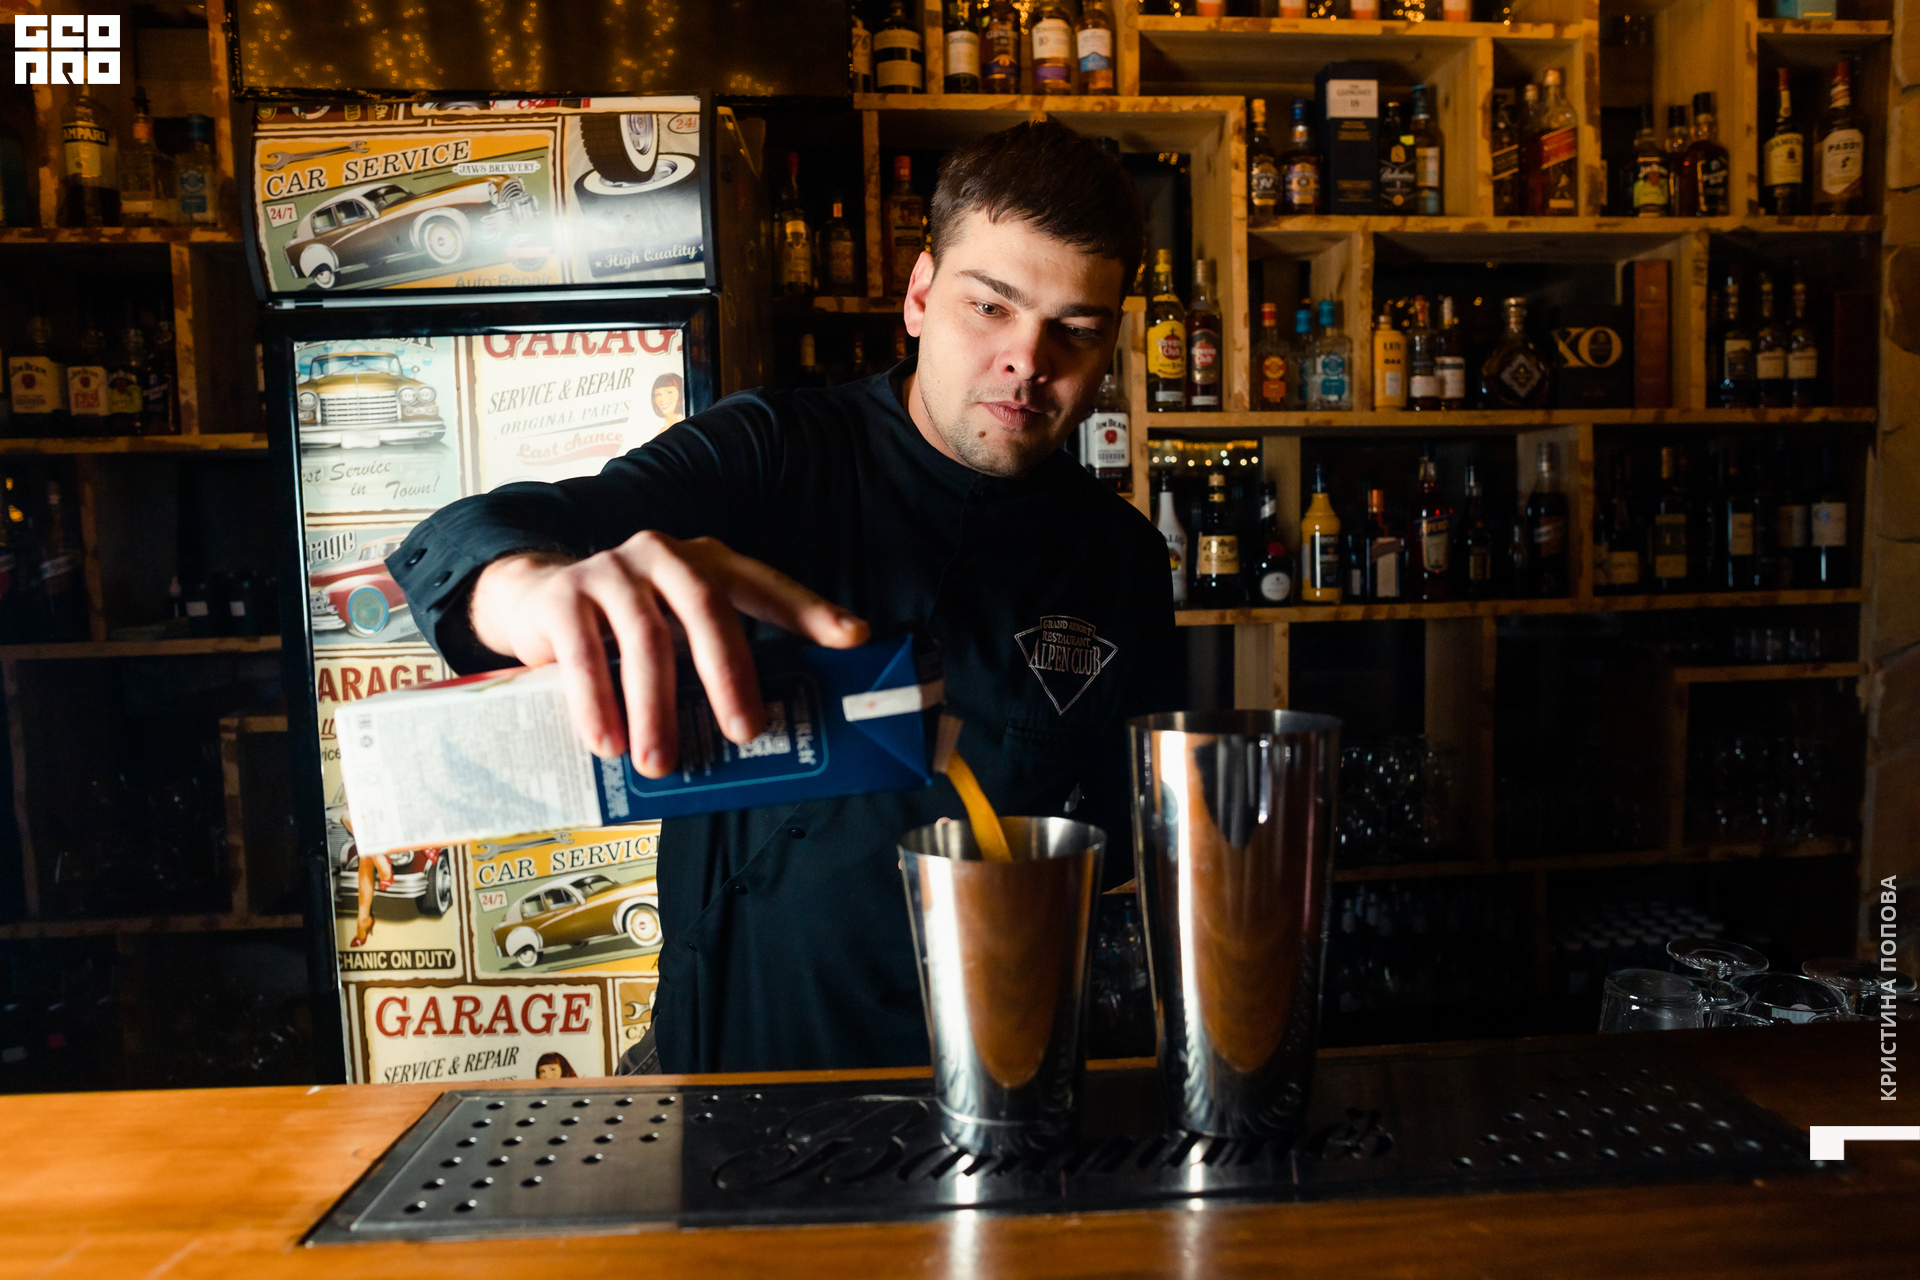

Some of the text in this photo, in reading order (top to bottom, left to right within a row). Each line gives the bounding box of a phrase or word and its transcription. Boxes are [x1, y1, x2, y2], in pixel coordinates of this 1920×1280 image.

[266, 140, 471, 198] CAR SERVICE
[459, 162, 535, 174] JAWS BREWERY
[270, 207, 294, 221] 24/7
[604, 244, 698, 270] High Quality
[455, 273, 552, 287] Auto Repair
[484, 329, 683, 359] GARAG
[1550, 326, 1623, 368] XO
[488, 367, 635, 415] SERVICE & REPAIR
[500, 400, 631, 435] ORIGINAL PARTS
[516, 430, 624, 460] Last chance
[330, 461, 391, 481] Service
[351, 475, 440, 500] in Town!
[1042, 630, 1091, 648] RESTAURANT
[1043, 620, 1093, 636] GRAND RESORT
[1028, 638, 1101, 676] ALPEN CLUB
[479, 859, 535, 885] CAR
[481, 892, 505, 906] 24/7
[390, 950, 412, 968] ON
[415, 949, 453, 968] DUTY
[375, 993, 592, 1037] GARAGE
[383, 1046, 520, 1084] SERVICE & REPAIR
